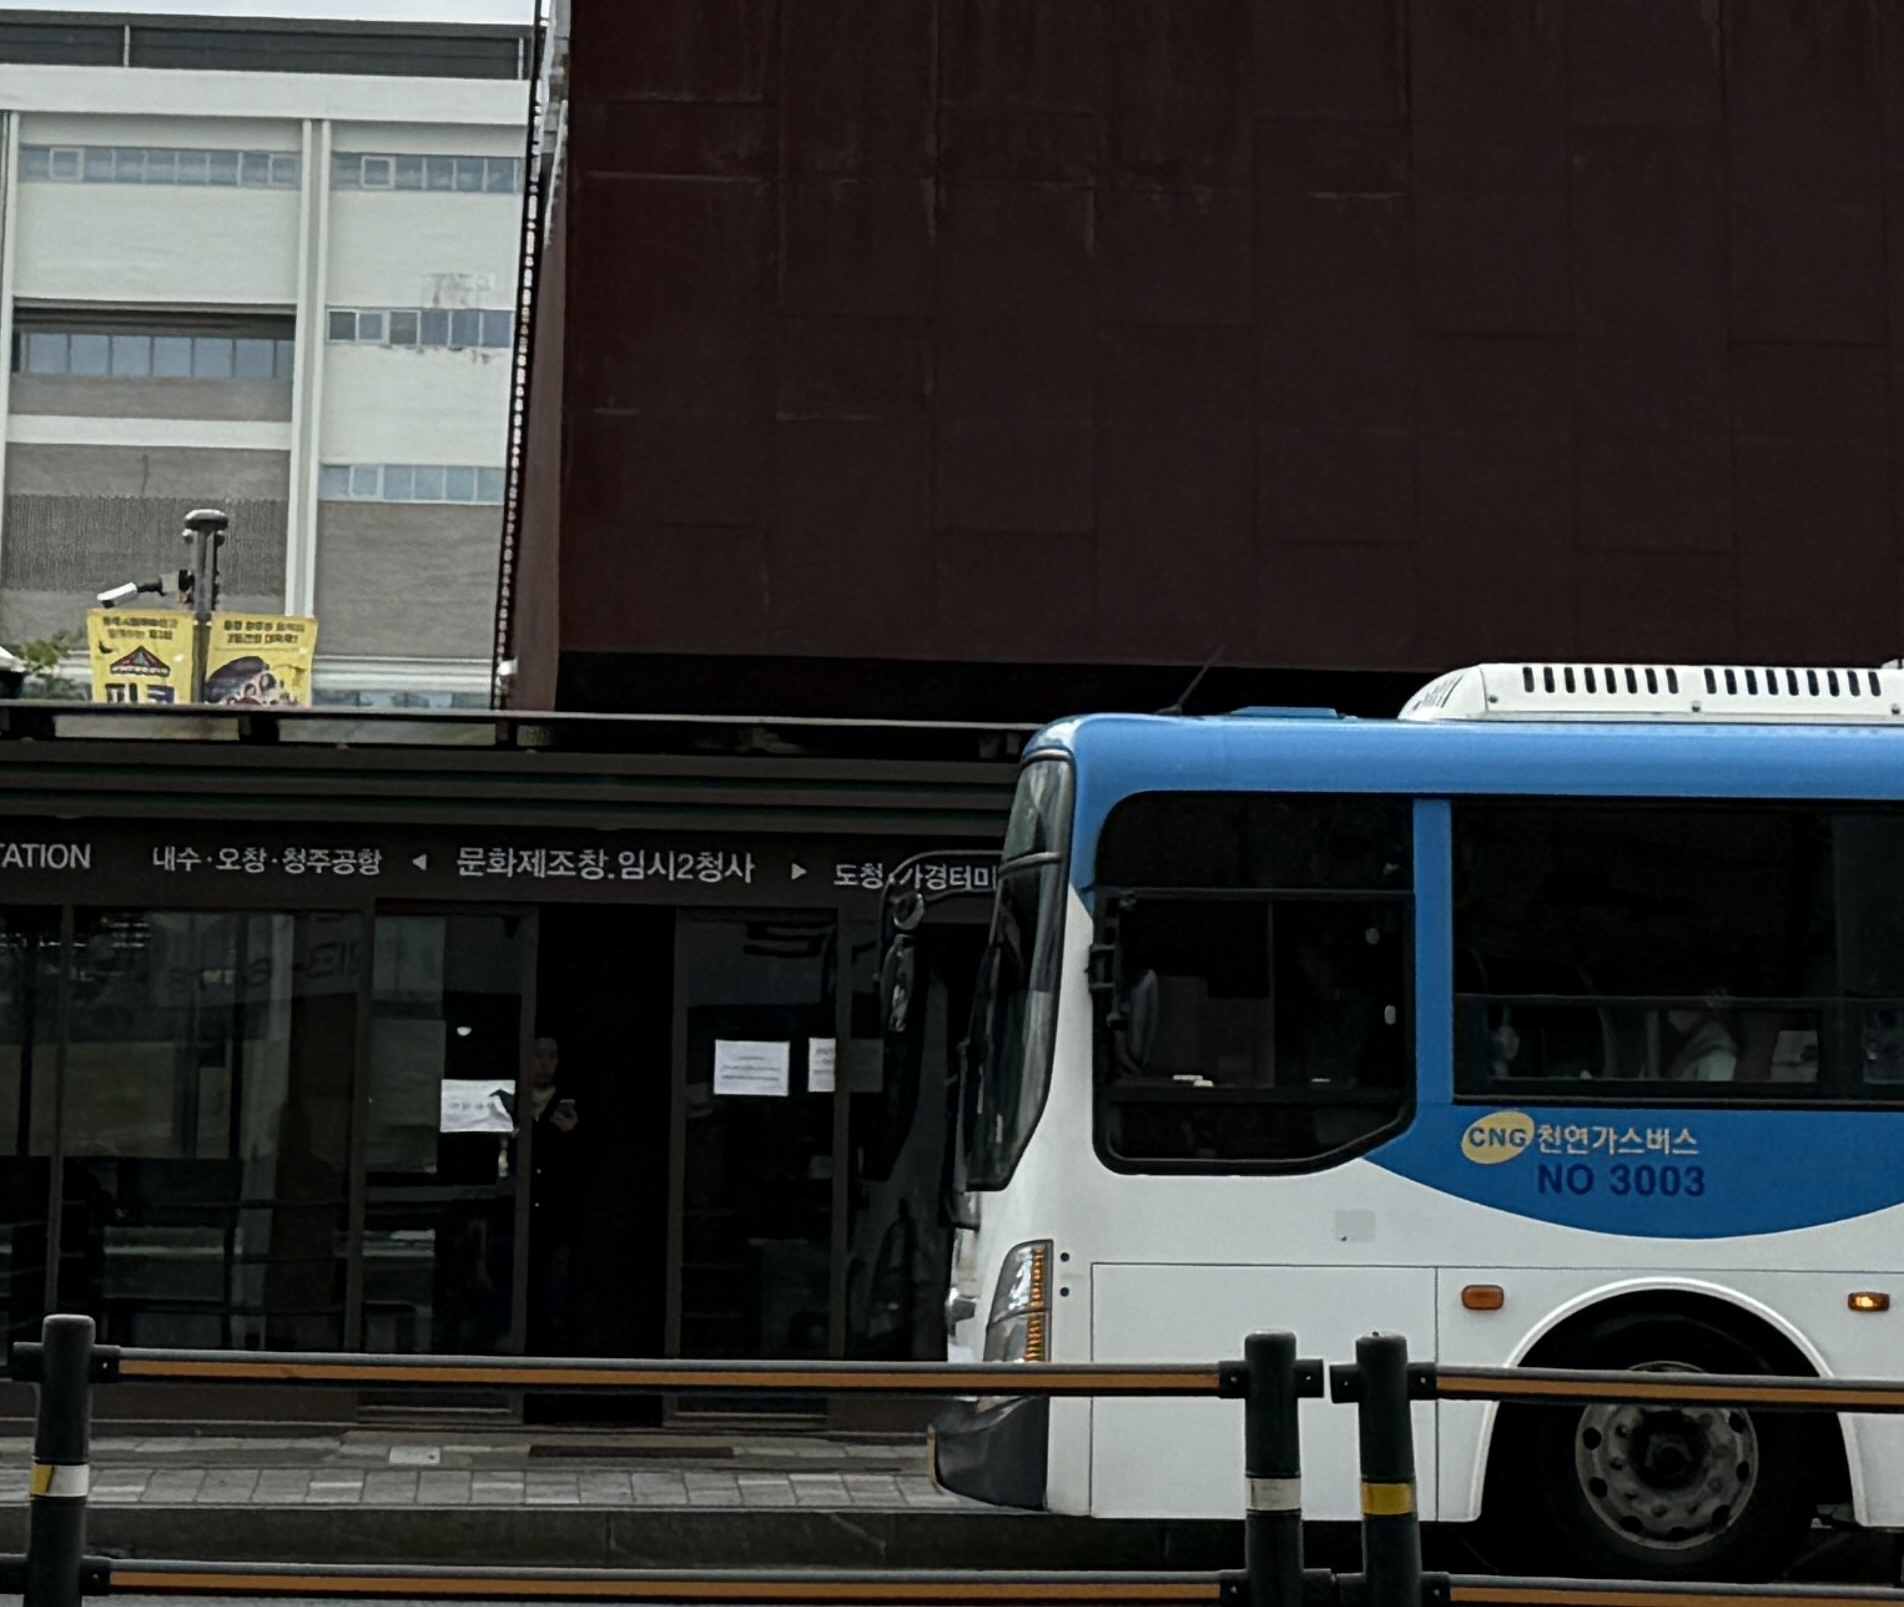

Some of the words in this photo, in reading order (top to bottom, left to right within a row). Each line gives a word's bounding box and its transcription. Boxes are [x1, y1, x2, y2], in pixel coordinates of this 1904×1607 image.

[1467, 1126, 1527, 1148] CNG
[1537, 1124, 1700, 1156] 천연가스버스
[1537, 1163, 1594, 1195] NO
[1609, 1164, 1706, 1197] 3003
